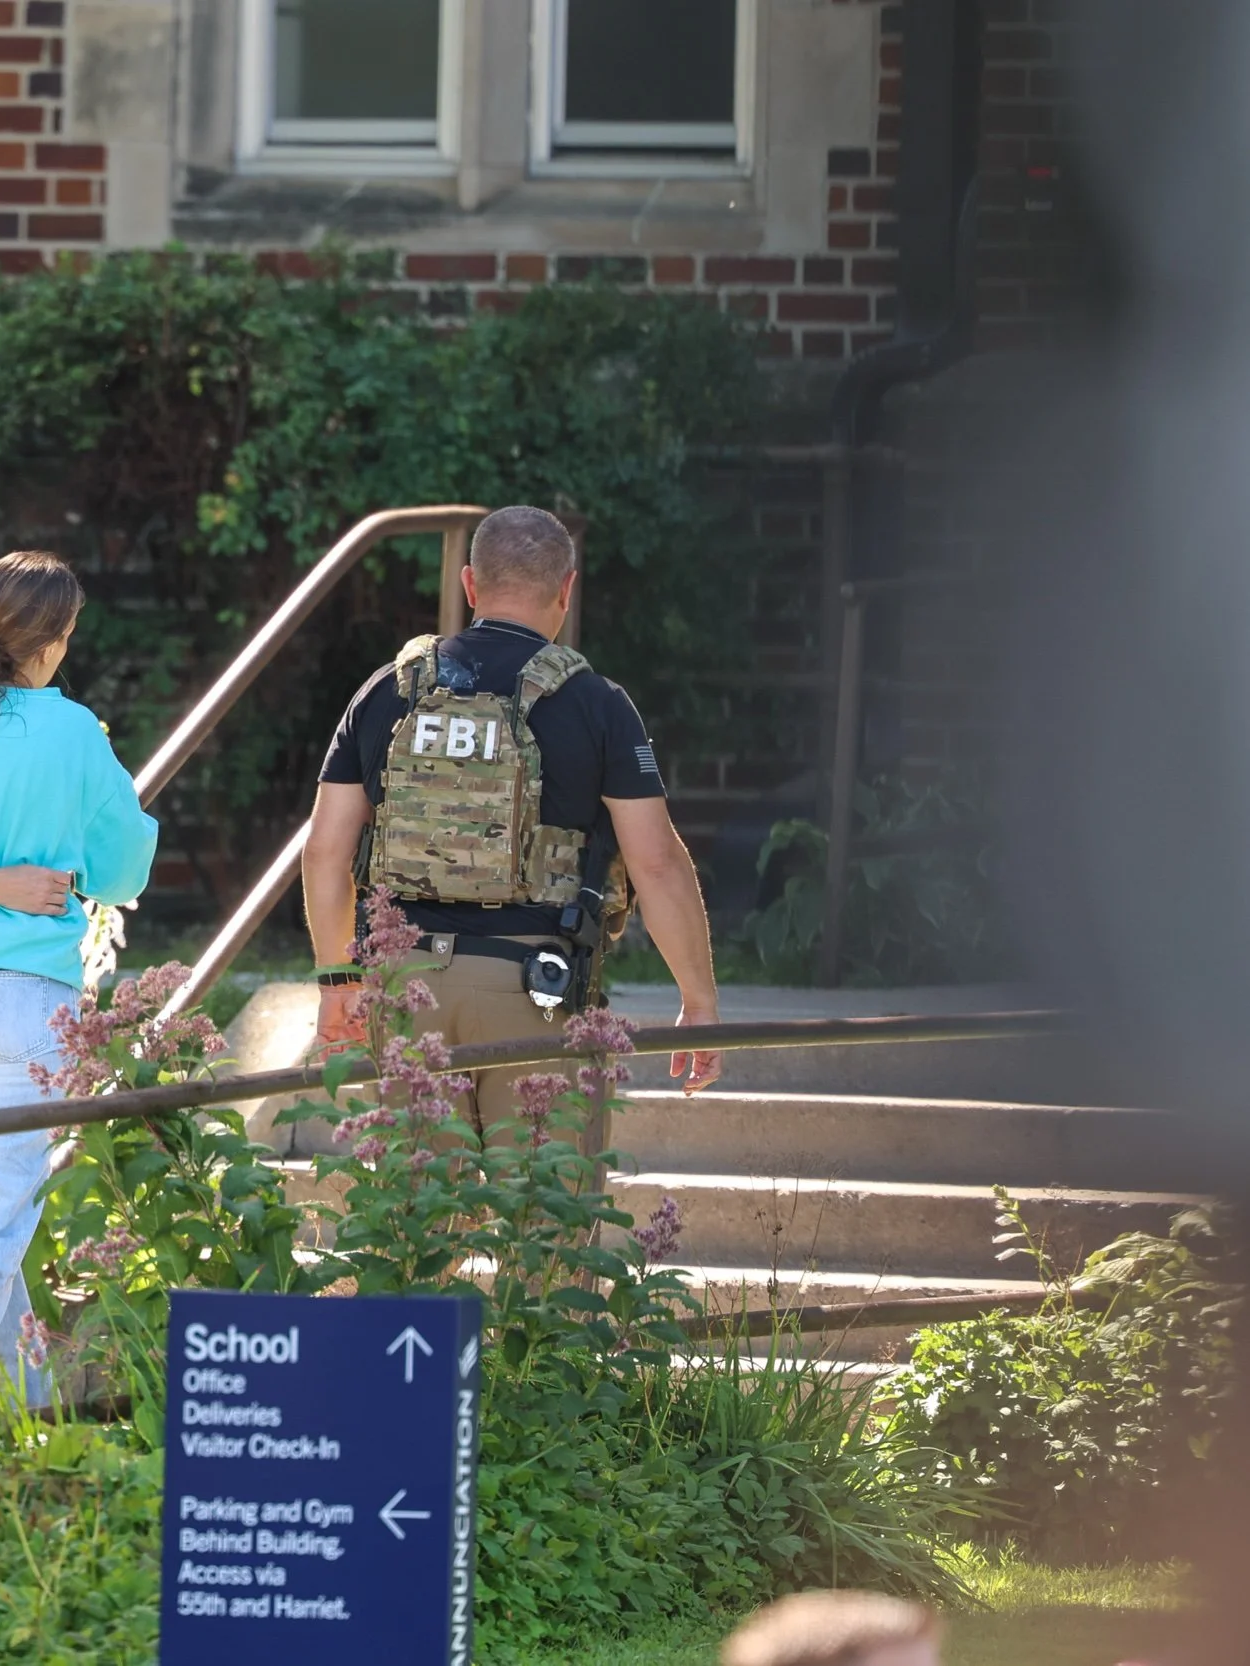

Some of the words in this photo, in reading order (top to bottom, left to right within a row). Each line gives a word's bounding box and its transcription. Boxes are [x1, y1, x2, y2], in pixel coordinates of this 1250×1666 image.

[413, 714, 497, 760] FBI
[185, 1324, 298, 1363] School
[183, 1369, 246, 1394] Office
[183, 1401, 281, 1426] Deliveries
[182, 1433, 245, 1457] Visitor
[249, 1434, 339, 1458] Check-In
[181, 1496, 258, 1526] Parking
[261, 1501, 301, 1522] and
[305, 1499, 353, 1528] Gym
[180, 1528, 252, 1553] Behind
[178, 1561, 252, 1585] Access
[255, 1563, 285, 1585] via
[178, 1592, 226, 1615] 55th
[230, 1596, 269, 1617] and
